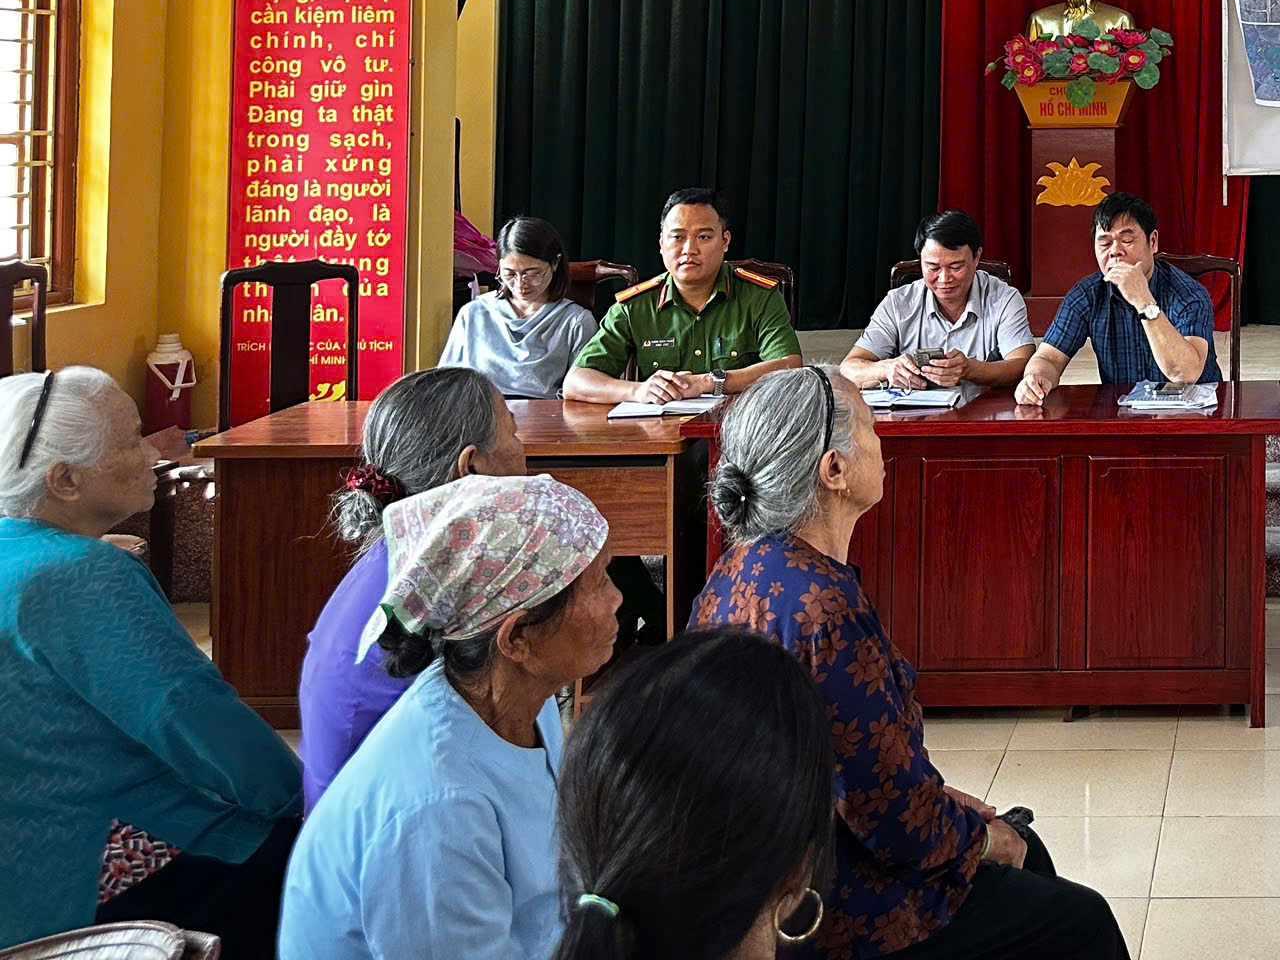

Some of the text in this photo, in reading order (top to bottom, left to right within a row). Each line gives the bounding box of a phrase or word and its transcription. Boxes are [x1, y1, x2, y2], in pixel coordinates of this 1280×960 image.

[250, 2, 395, 29] cần kiệm liêm
[249, 29, 396, 52] chính, chí
[249, 54, 394, 79] công vô tư.
[249, 79, 394, 103] Phải giữ gìn
[1048, 86, 1066, 96] CH
[247, 103, 394, 128] Đảng ta thật
[1039, 96, 1054, 117] HỒ
[247, 128, 392, 153] trong sạch,
[247, 153, 392, 177] phải xứng
[246, 178, 391, 203] đáng là người
[245, 202, 391, 227] lãnh đạo, là
[244, 224, 392, 253] người đầy tớ
[236, 340, 267, 352] TRÍCH
[316, 338, 342, 351] CỦA
[368, 339, 394, 353] TỊCH
